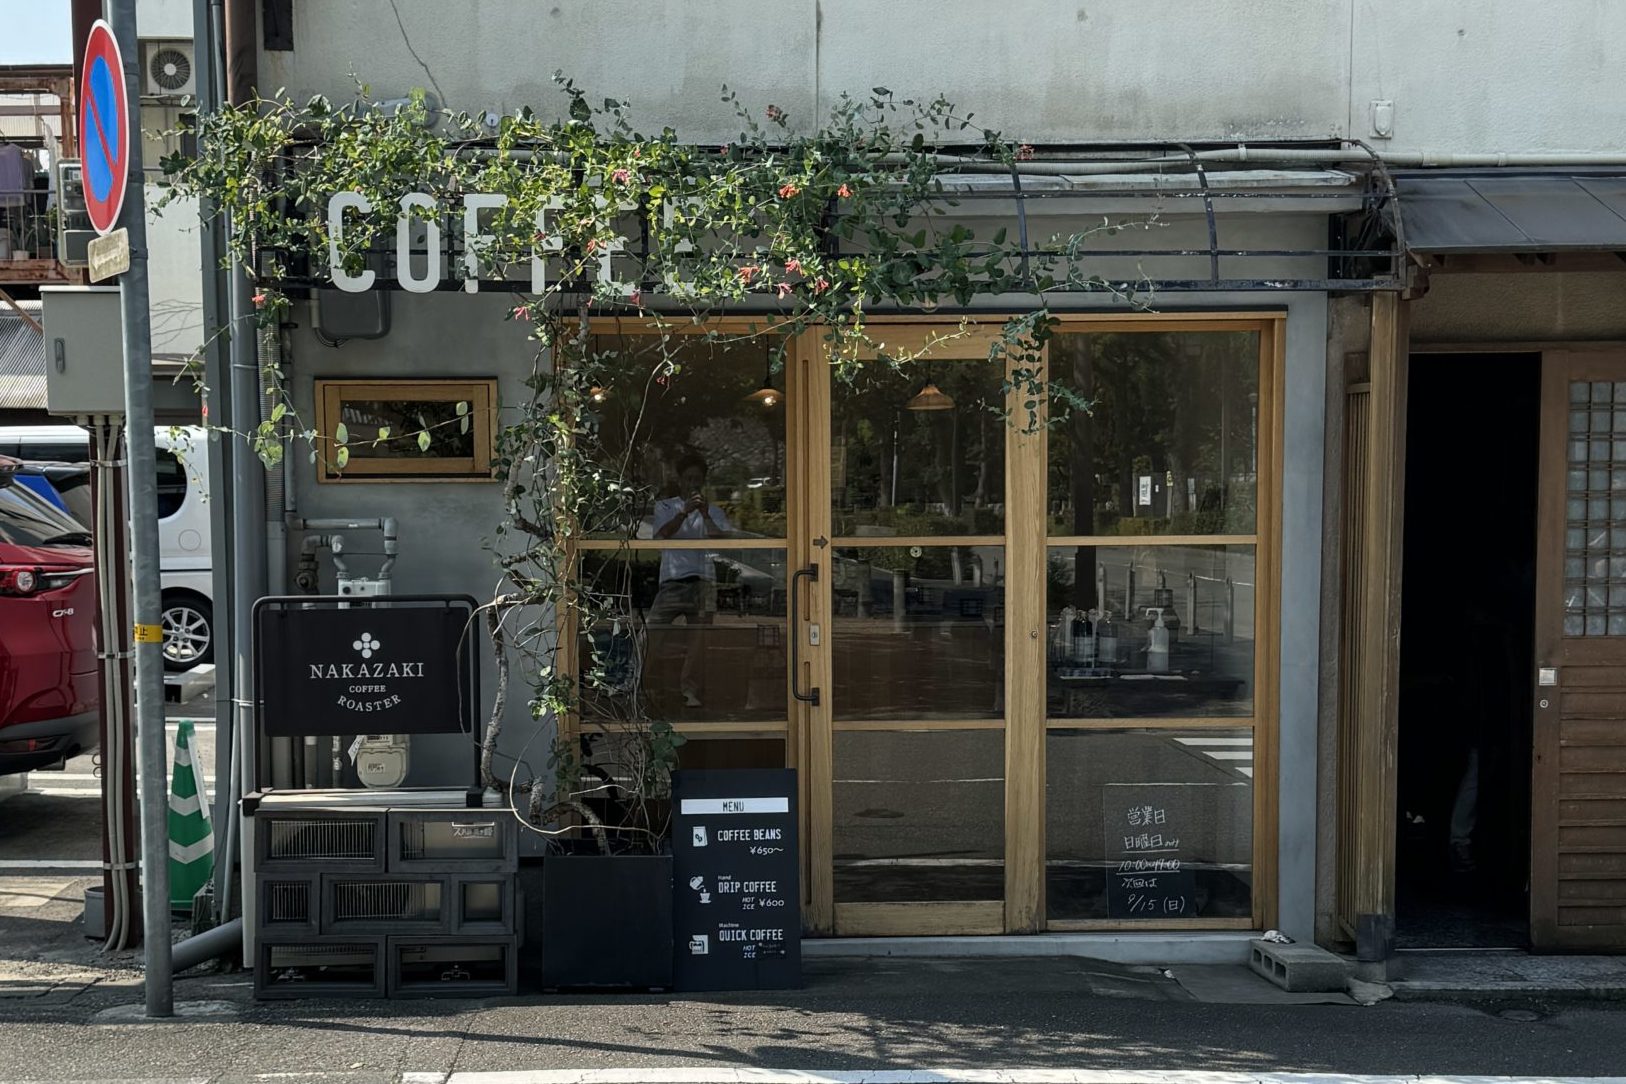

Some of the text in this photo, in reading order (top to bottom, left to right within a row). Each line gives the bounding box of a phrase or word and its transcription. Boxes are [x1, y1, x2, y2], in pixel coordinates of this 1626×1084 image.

[309, 662, 425, 679] NAKAZAKI
[348, 685, 387, 693] COFFEE
[337, 694, 402, 712] ROASTER
[722, 801, 745, 812] MENU
[1127, 805, 1166, 826] 営業日
[717, 828, 782, 841] COFFEE BEANS
[718, 880, 777, 893] DRIP COFFEE
[759, 898, 785, 907] ¥600
[719, 928, 784, 941] QUICK COFFEE
